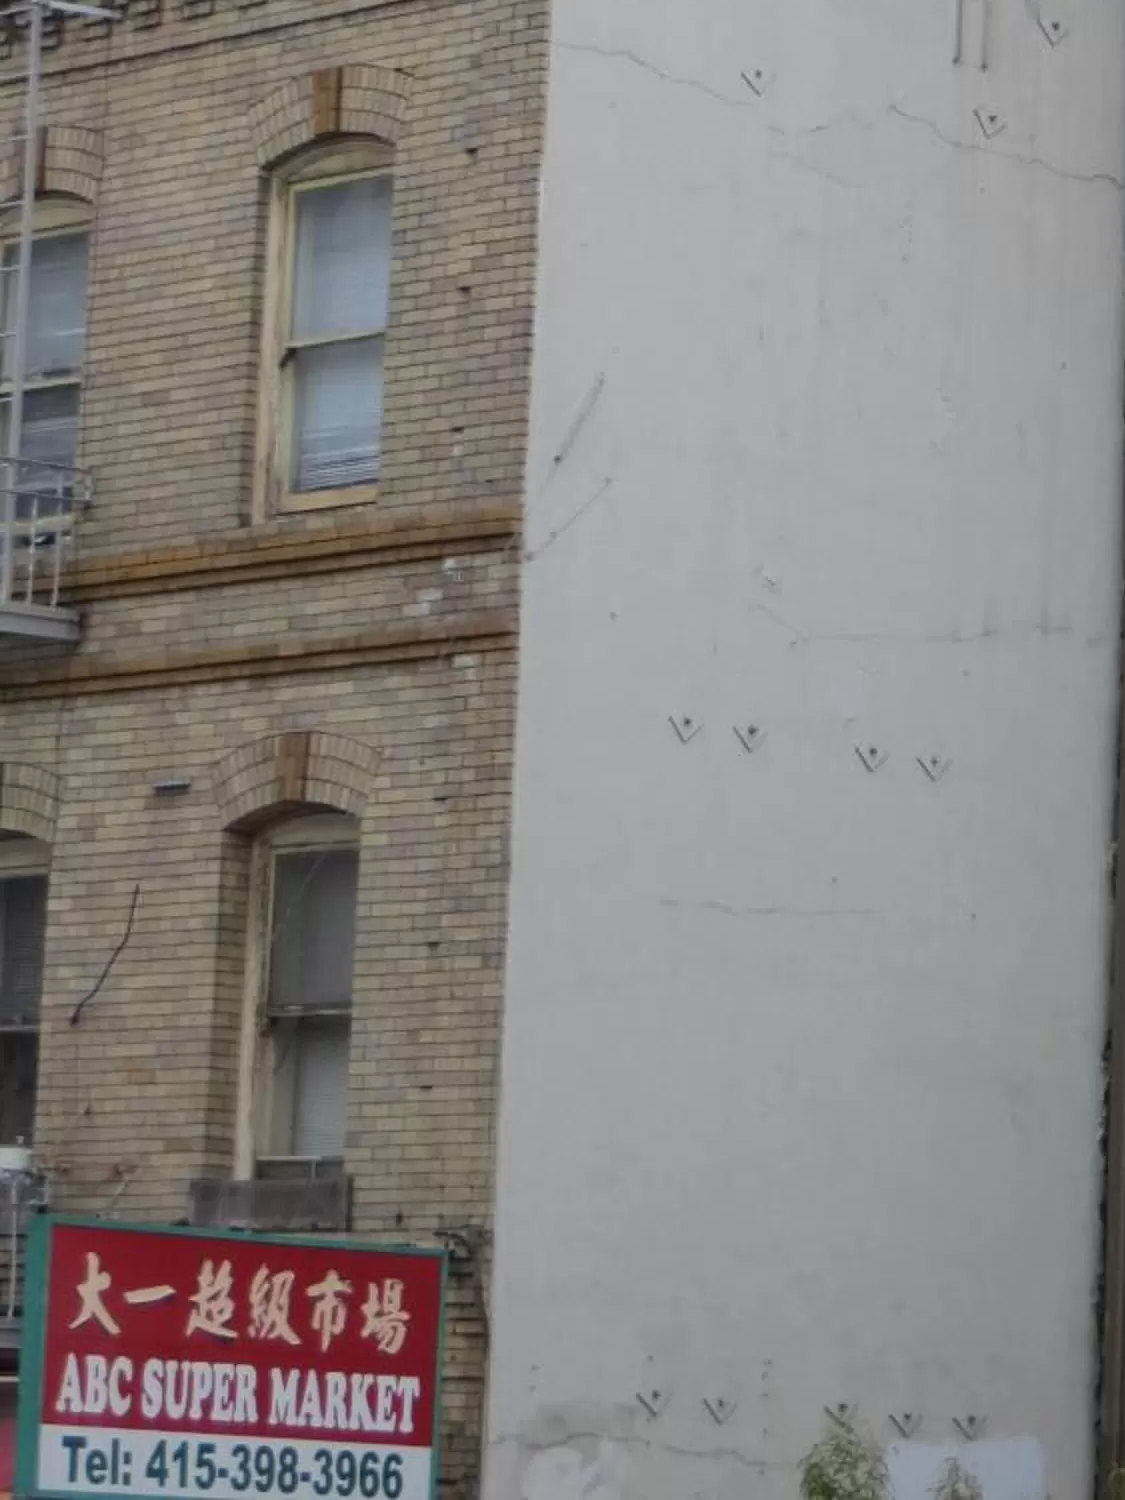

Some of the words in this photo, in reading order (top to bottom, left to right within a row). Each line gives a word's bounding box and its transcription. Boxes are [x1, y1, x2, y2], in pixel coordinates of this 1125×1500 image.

[68, 1250, 411, 1355] 大一超級市場
[55, 1351, 135, 1416] ABC
[141, 1357, 260, 1424] SUPER
[268, 1368, 420, 1433] MARKET
[61, 1435, 133, 1486] Tel:
[145, 1439, 404, 1500] 415-398-3966
